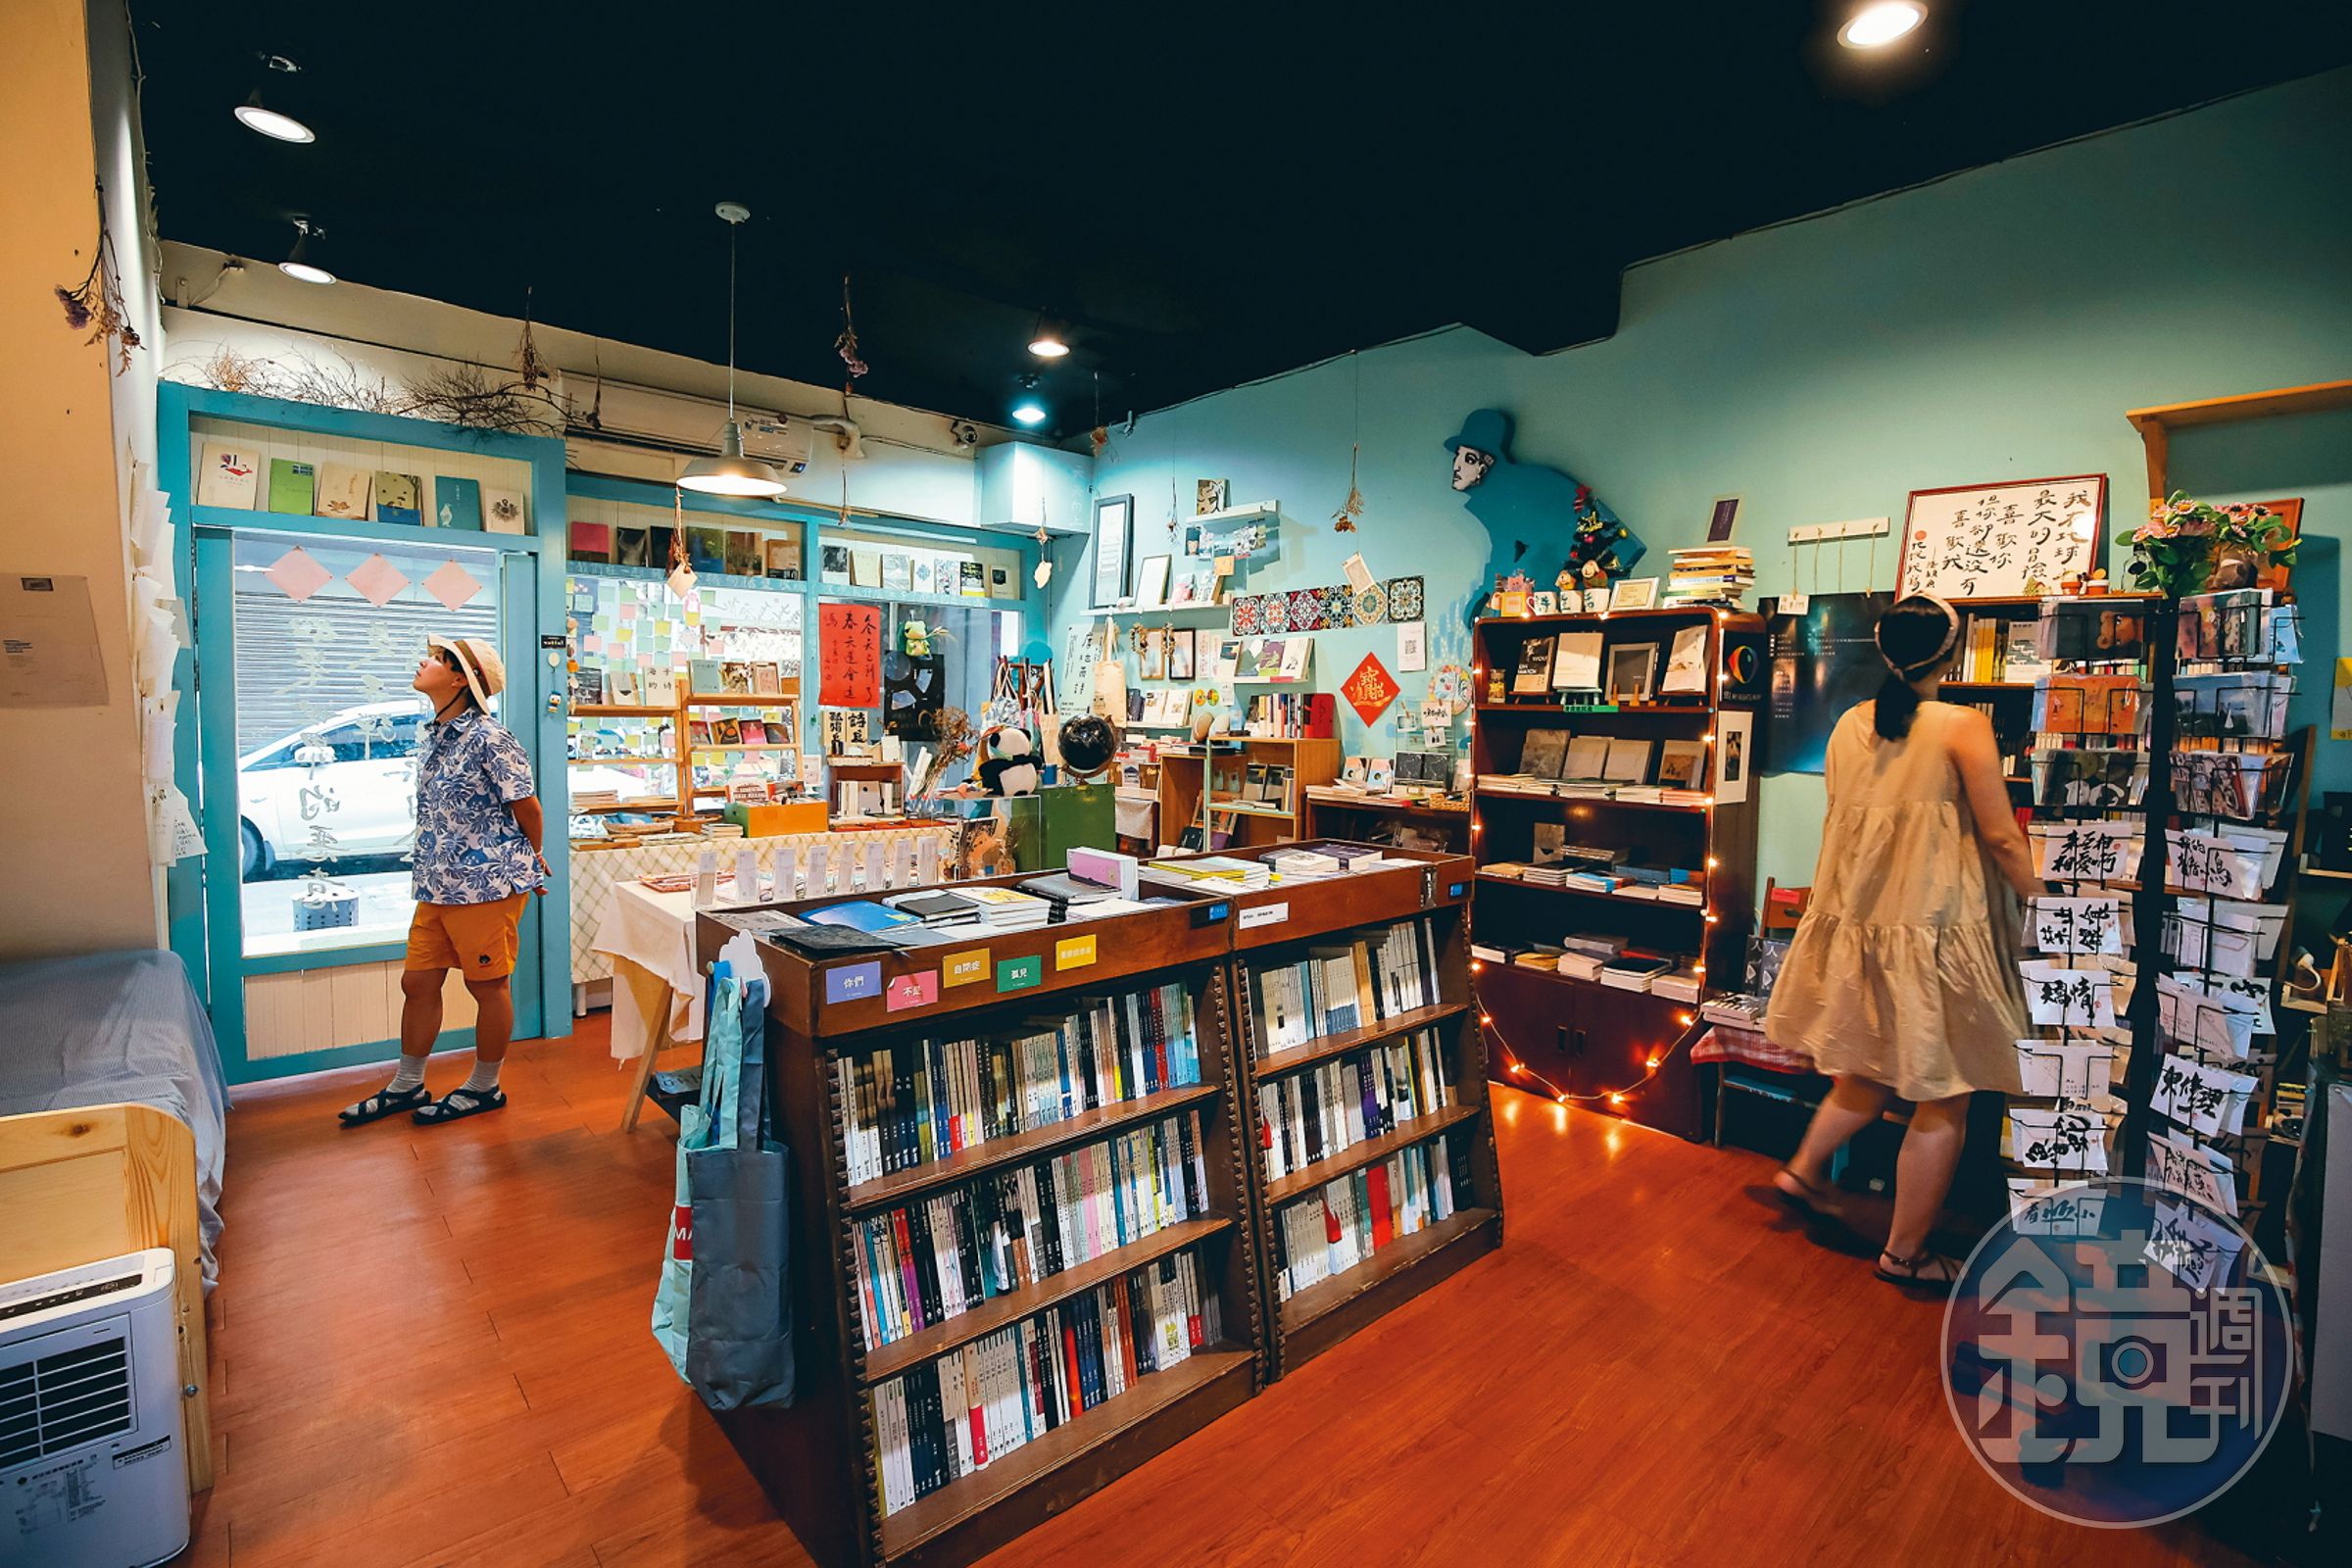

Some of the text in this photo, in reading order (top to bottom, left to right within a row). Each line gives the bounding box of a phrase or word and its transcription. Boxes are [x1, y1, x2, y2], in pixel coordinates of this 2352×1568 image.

[1942, 510, 1971, 570] 喜歡我
[1960, 494, 2000, 596] 但你卻還沒有
[1990, 504, 2025, 569] 喜歡你
[2022, 489, 2058, 579] 最大的冒險
[2052, 490, 2092, 580] 我在地球
[843, 975, 864, 989] 你們
[903, 985, 922, 997] 不是
